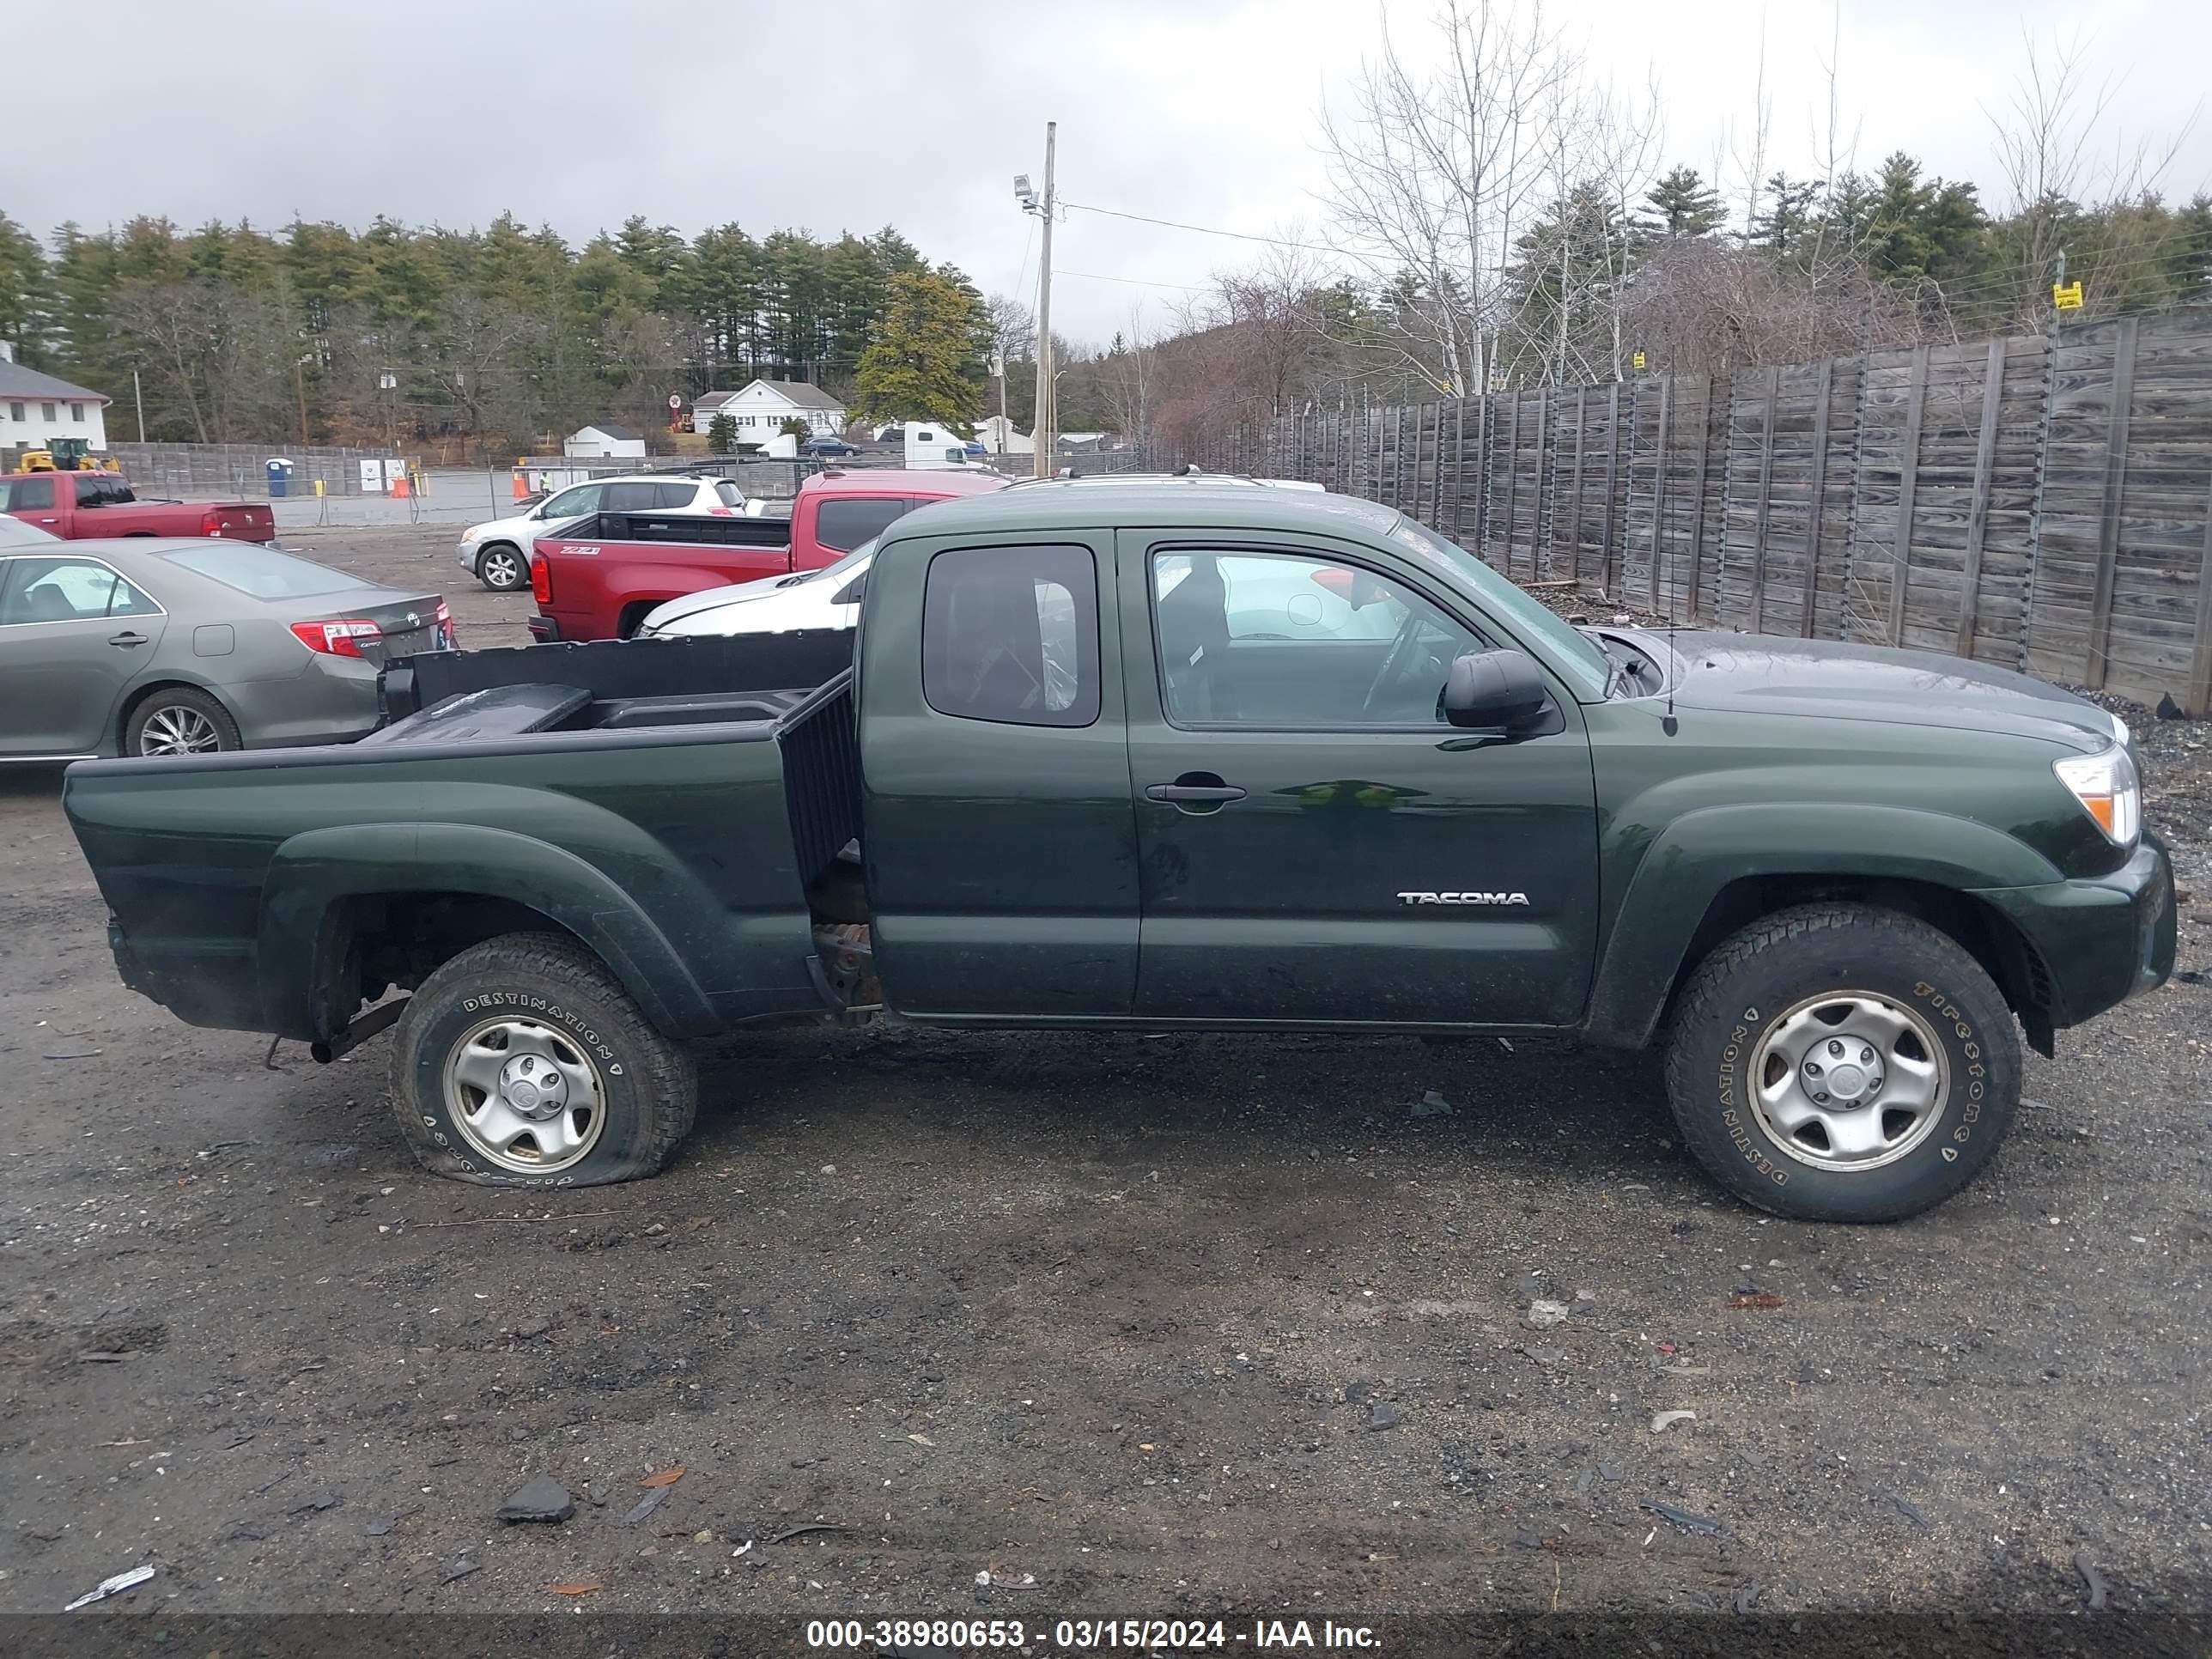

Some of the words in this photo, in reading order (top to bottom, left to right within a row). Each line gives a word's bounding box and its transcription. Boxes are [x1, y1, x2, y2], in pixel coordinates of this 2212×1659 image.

[560, 546, 601, 556] Z71
[1397, 892, 1529, 906] TACOMA
[464, 993, 613, 1060] DESTINATION
[1914, 981, 1984, 1143] Firestone
[1717, 1026, 1789, 1186] DESTINATION
